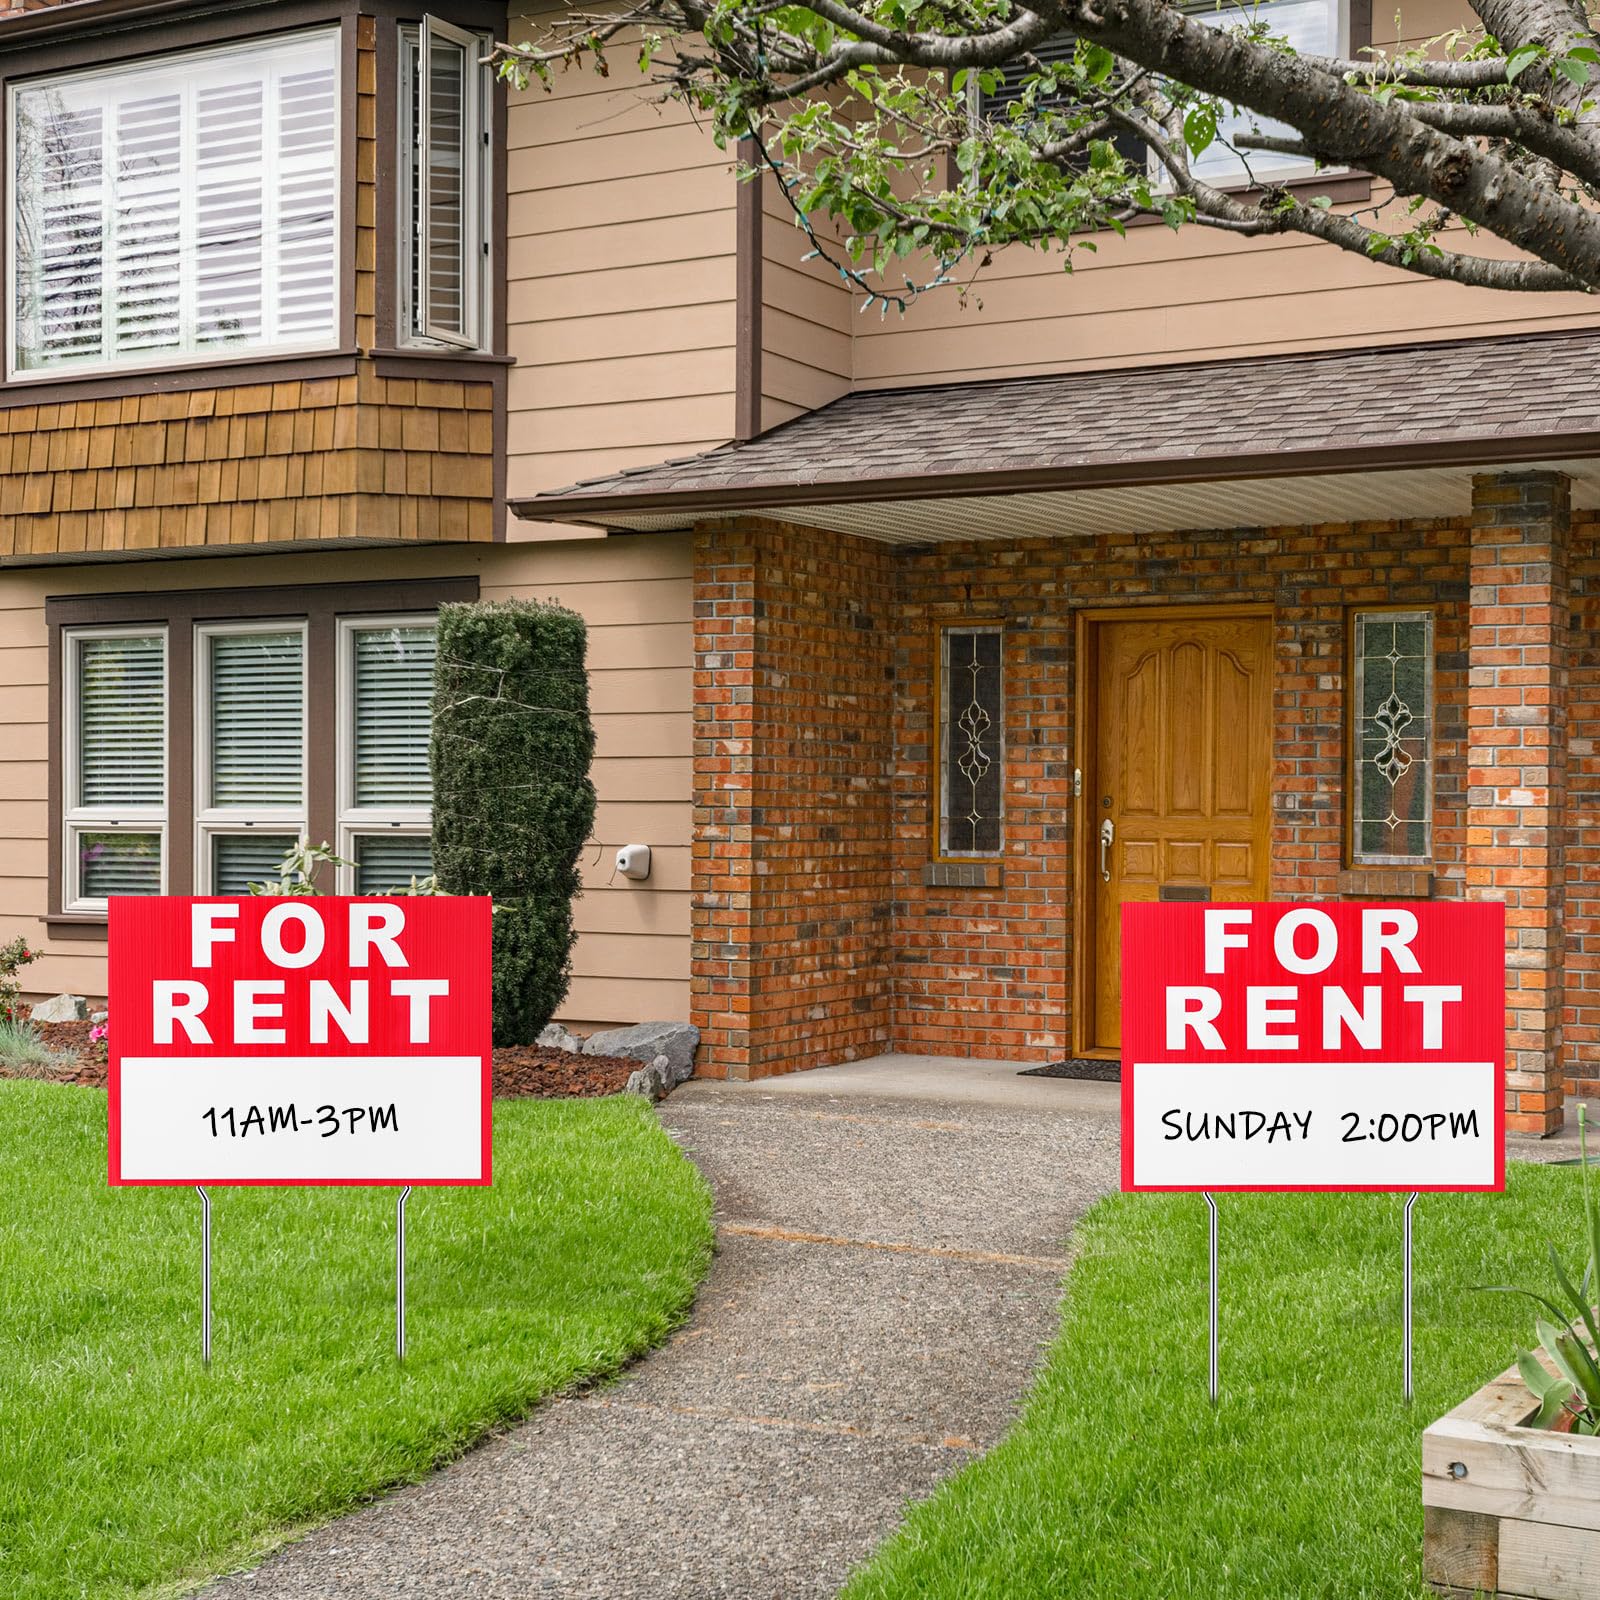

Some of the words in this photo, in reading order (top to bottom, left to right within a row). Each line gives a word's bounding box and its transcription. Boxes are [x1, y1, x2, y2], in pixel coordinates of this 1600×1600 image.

[191, 903, 410, 969] FOR
[1204, 908, 1423, 975] FOR
[152, 979, 450, 1044] RENT
[1165, 985, 1463, 1050] RENT
[202, 1103, 399, 1138] 11AM-3PM
[1161, 1108, 1313, 1144] SUNDAY
[1340, 1109, 1480, 1143] 2:00PM
